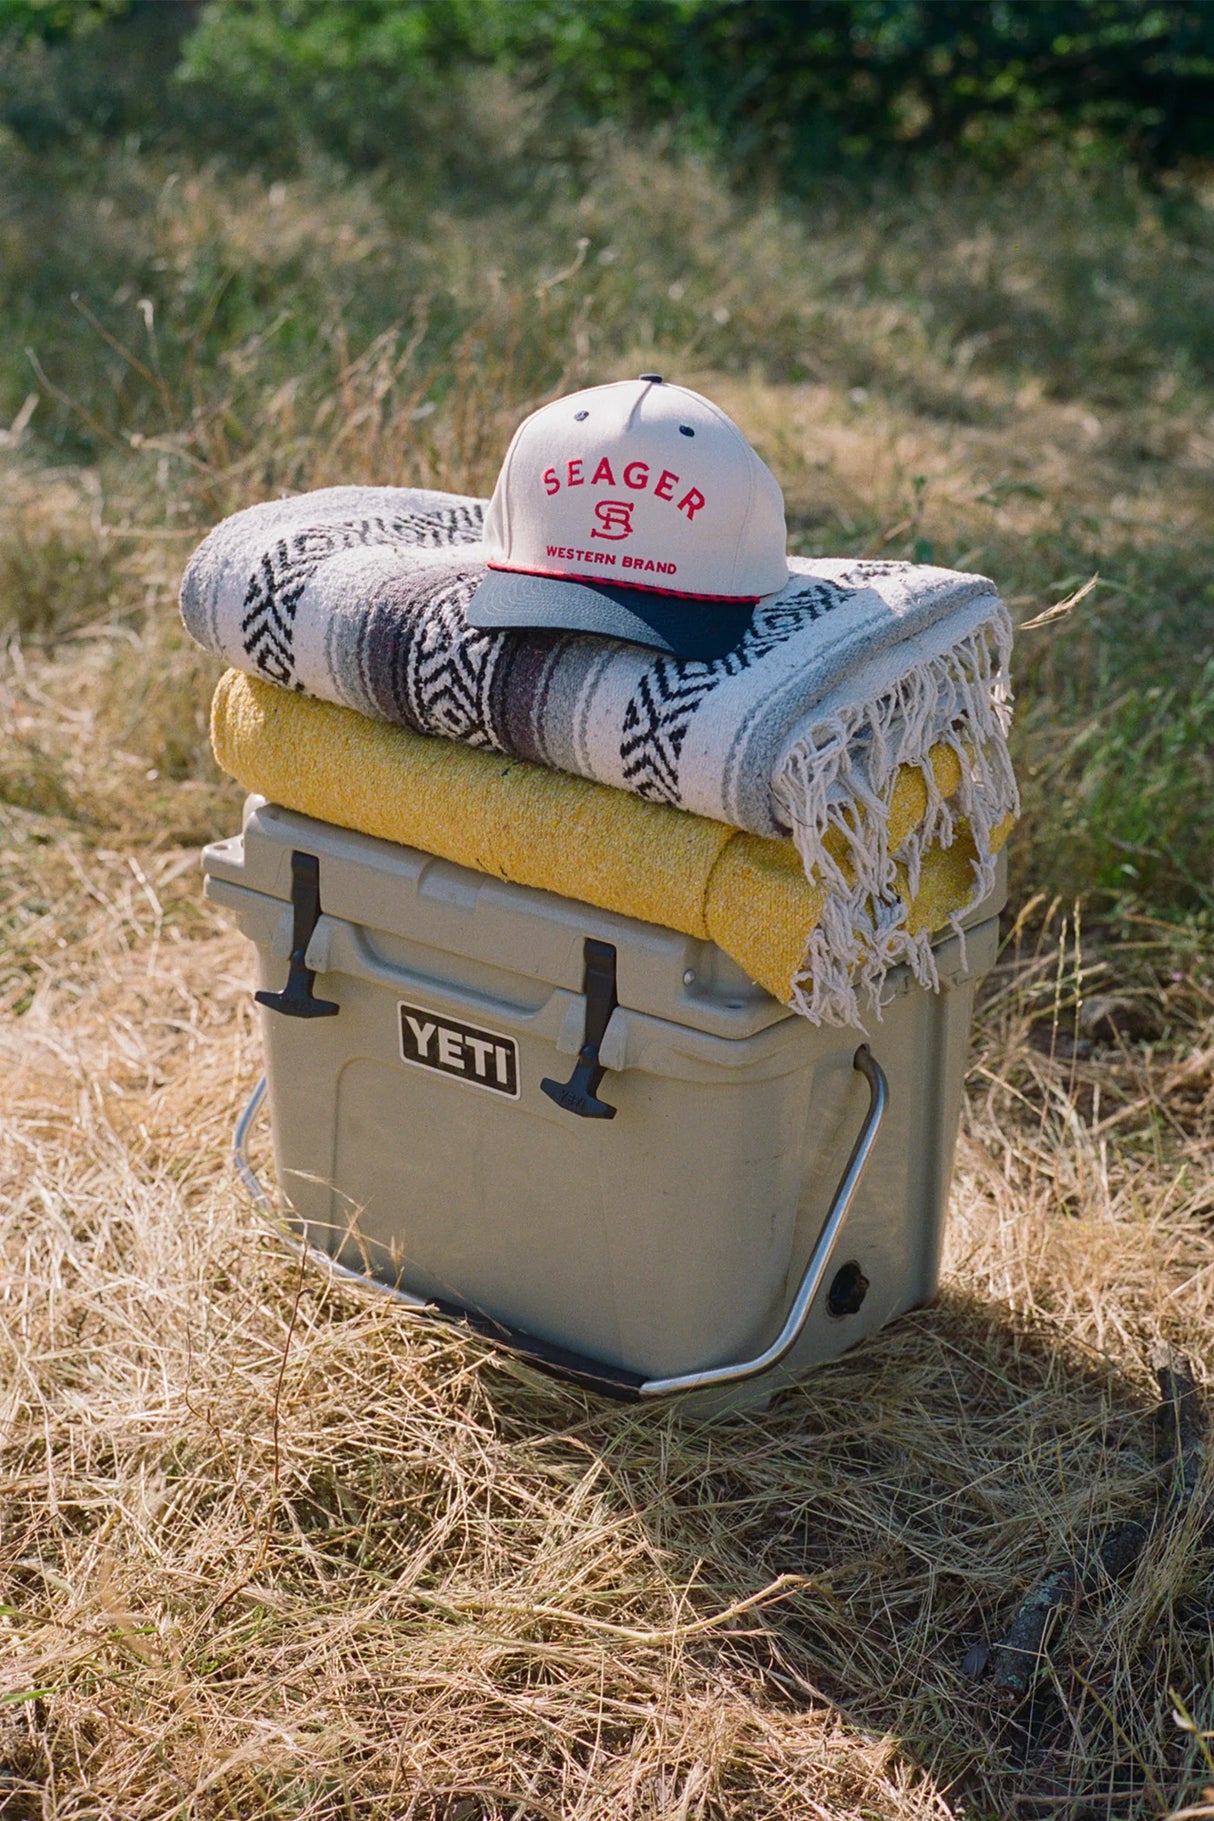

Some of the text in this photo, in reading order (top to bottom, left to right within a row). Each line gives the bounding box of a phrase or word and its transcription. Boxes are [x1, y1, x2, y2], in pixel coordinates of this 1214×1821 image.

[542, 457, 705, 521] SEAGER
[546, 545, 677, 575] WESTERN BRAND
[405, 1015, 509, 1085] YETI
